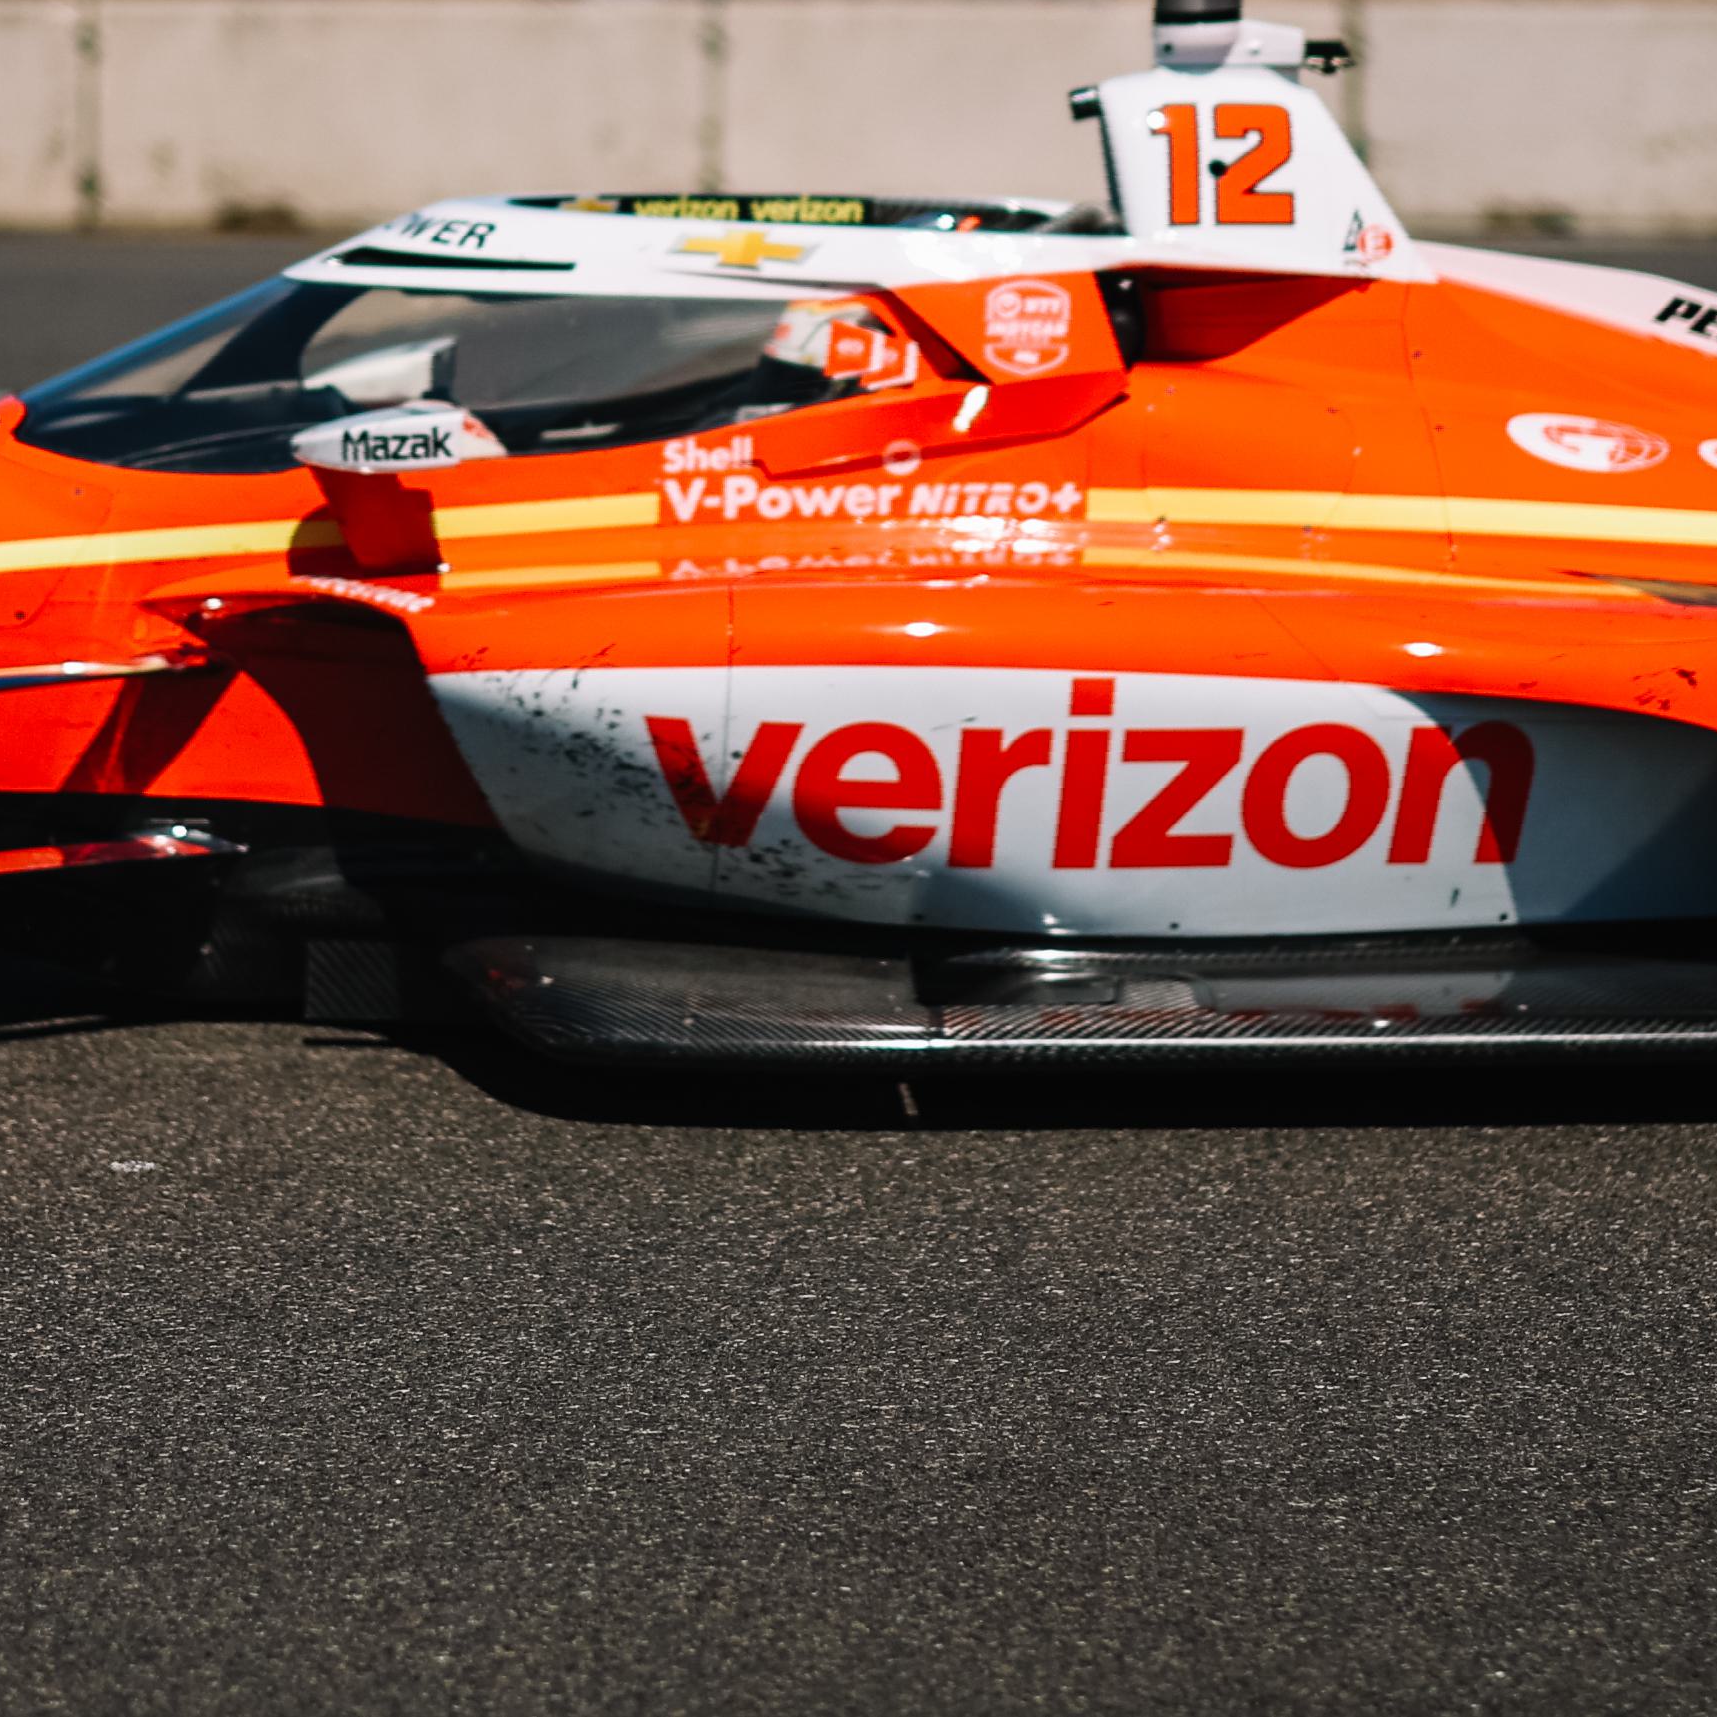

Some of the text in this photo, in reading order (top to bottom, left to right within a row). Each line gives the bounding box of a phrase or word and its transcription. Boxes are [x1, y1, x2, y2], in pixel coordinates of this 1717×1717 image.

[1149, 103, 1294, 225] 12
[635, 193, 864, 223] verizon verizon
[341, 425, 454, 462] Mazak
[662, 436, 754, 474] Shell
[664, 474, 902, 523] V-Power
[645, 678, 1535, 869] verizon
